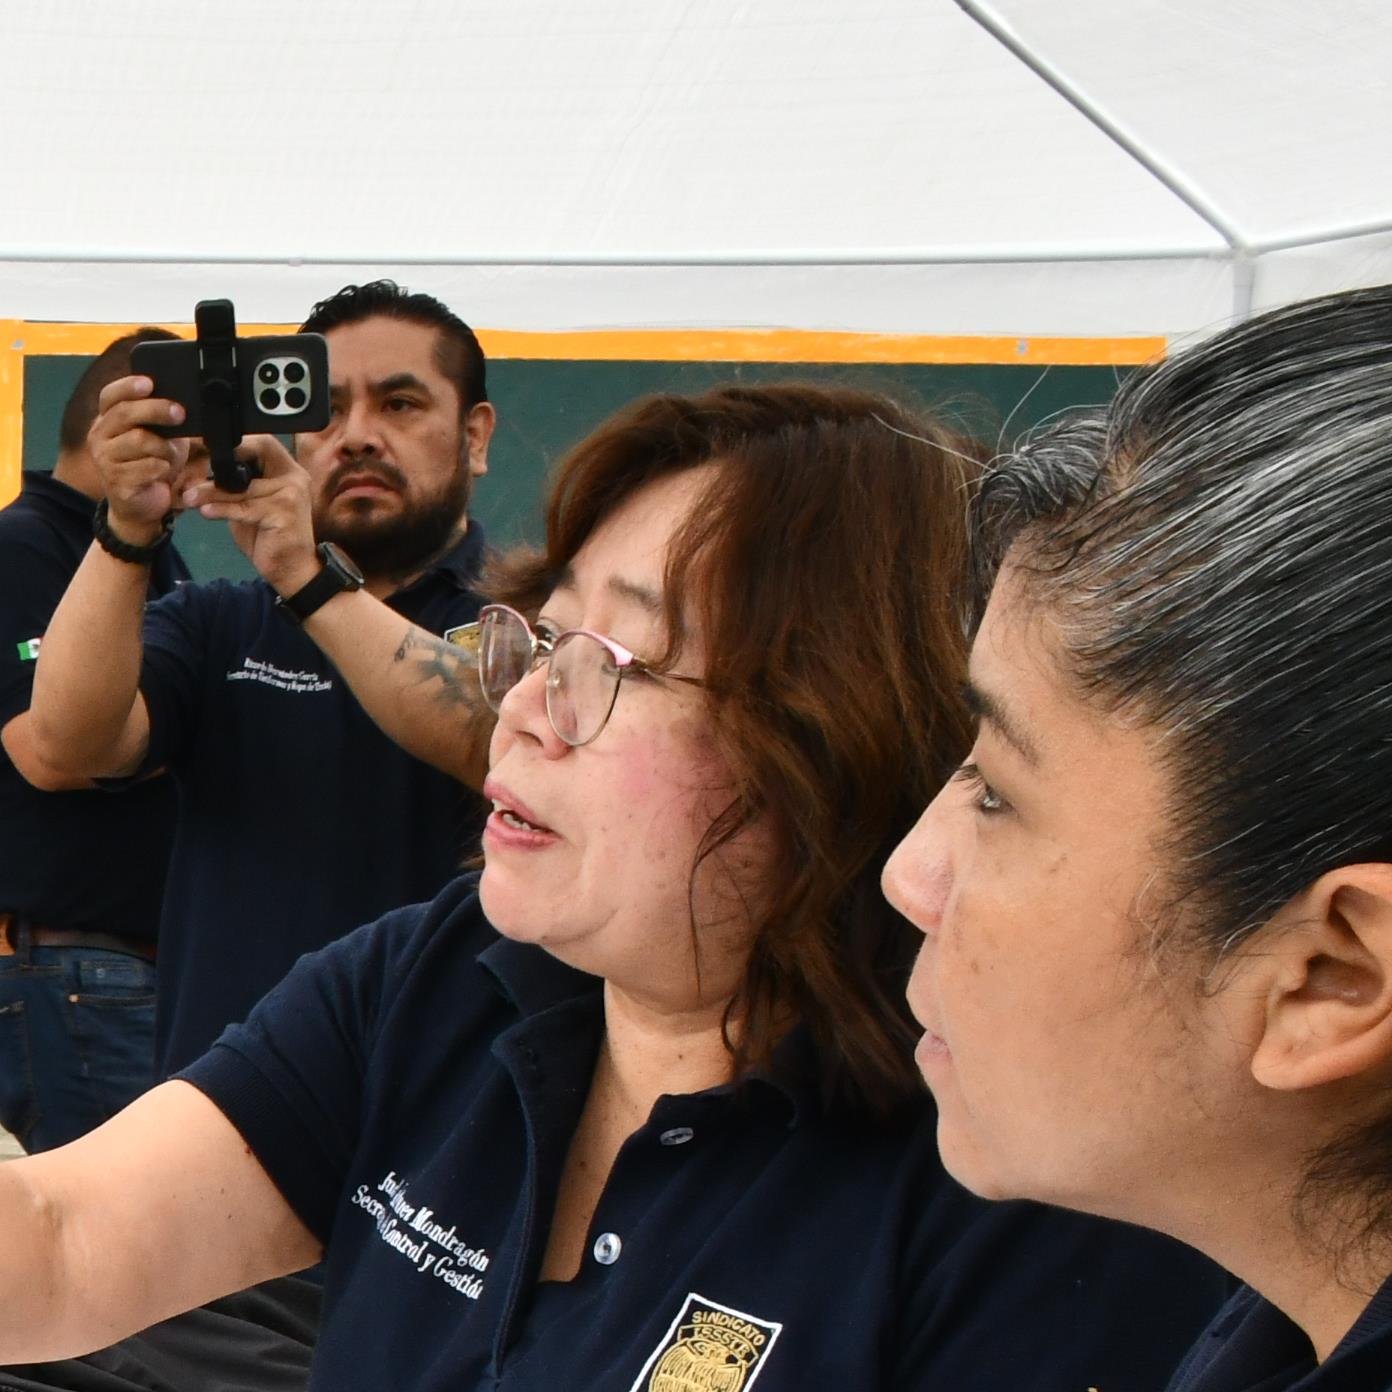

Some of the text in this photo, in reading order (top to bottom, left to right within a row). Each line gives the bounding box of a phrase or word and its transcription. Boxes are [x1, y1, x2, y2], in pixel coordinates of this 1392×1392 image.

[408, 1206, 490, 1272] Mondragón
[417, 1253, 436, 1272] y
[692, 1310, 766, 1347] SINDICATO
